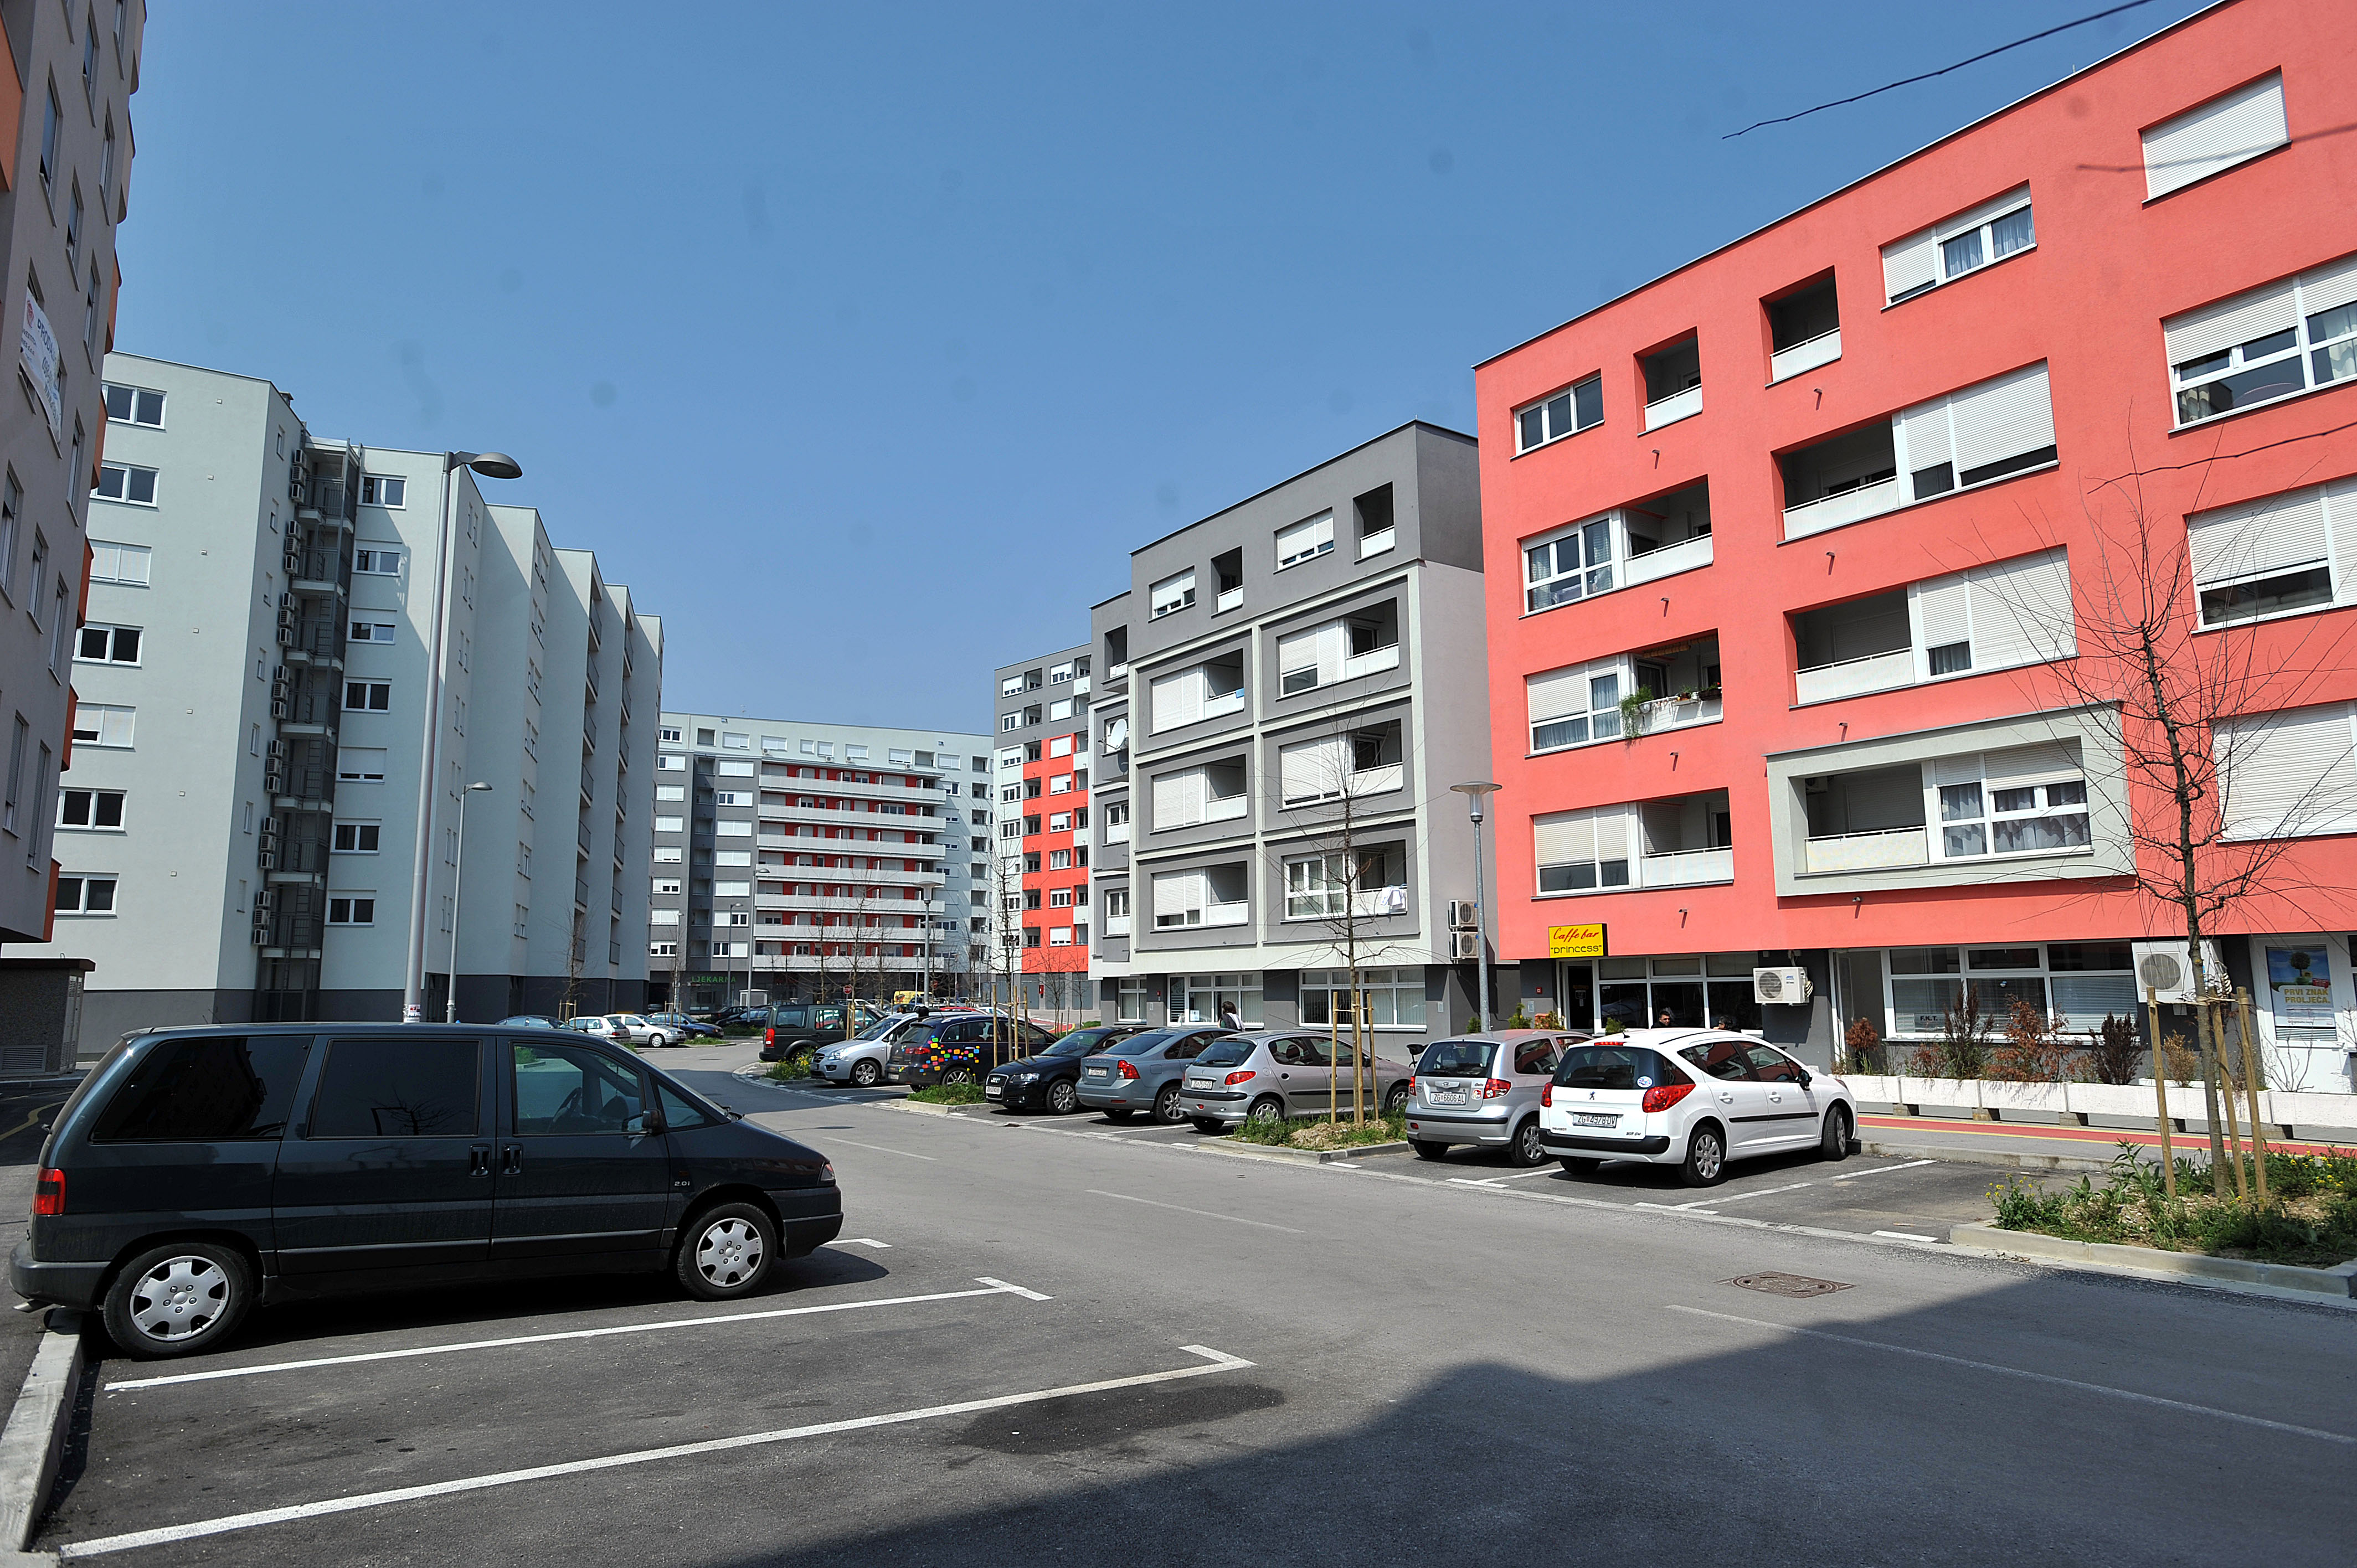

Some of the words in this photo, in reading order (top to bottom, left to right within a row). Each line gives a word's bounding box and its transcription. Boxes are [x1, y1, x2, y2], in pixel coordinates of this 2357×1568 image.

[1553, 927, 1579, 942] Caffe
[1581, 929, 1599, 939] bar
[1578, 1115, 1586, 1123] ZG
